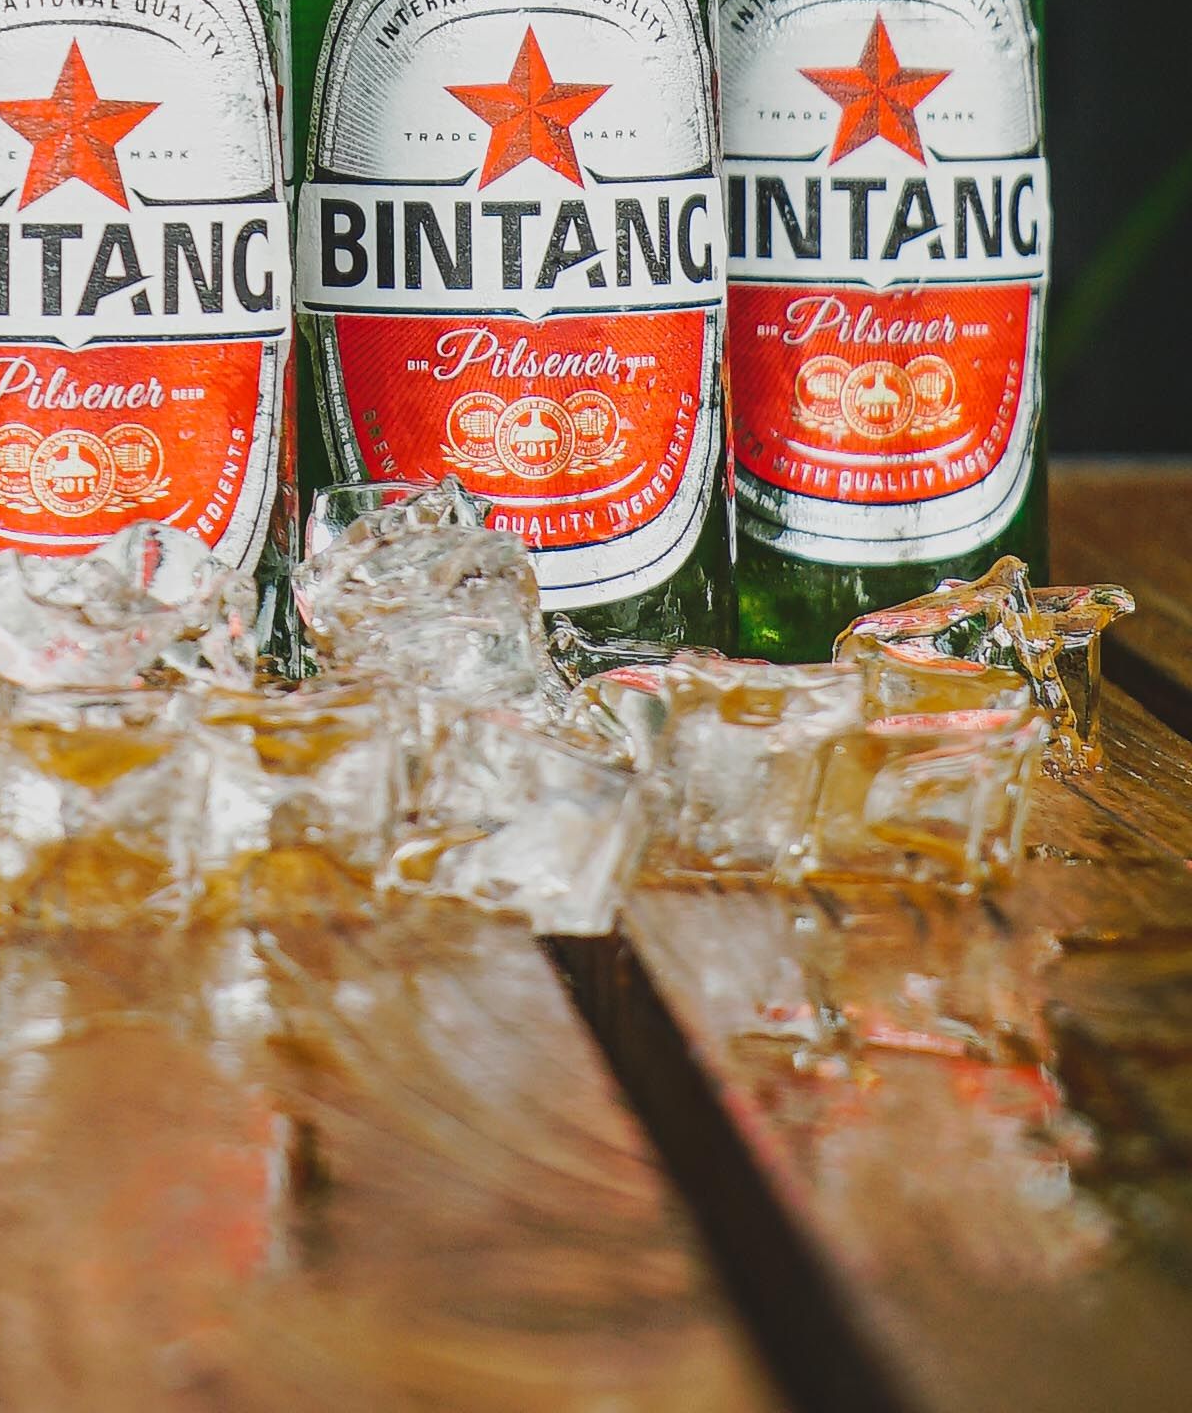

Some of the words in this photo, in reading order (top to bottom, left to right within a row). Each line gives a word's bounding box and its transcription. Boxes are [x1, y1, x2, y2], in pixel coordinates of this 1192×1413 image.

[404, 132, 478, 142] TRADE
[584, 130, 638, 139] MARK
[758, 111, 827, 121] TRADE
[926, 111, 976, 121] MARK
[129, 149, 191, 160] MARK
[320, 193, 713, 290] BINTANG
[727, 174, 1039, 260] INTANG
[783, 295, 956, 347] Pilsener
[407, 359, 429, 371] BIR
[433, 326, 619, 382] Pilsener
[626, 356, 656, 368] BEER
[171, 388, 205, 401] BEER
[861, 404, 898, 418] 2011
[363, 409, 405, 479] BREW
[516, 441, 557, 457] 2011
[773, 454, 828, 487] WITH
[839, 467, 936, 492] QUALITY
[943, 358, 1020, 485] INGREDIENTS
[52, 477, 96, 493] 2011
[186, 427, 246, 538] EDIENTS
[494, 510, 596, 535] QUALITY
[608, 391, 694, 523] INGREDIENTS
